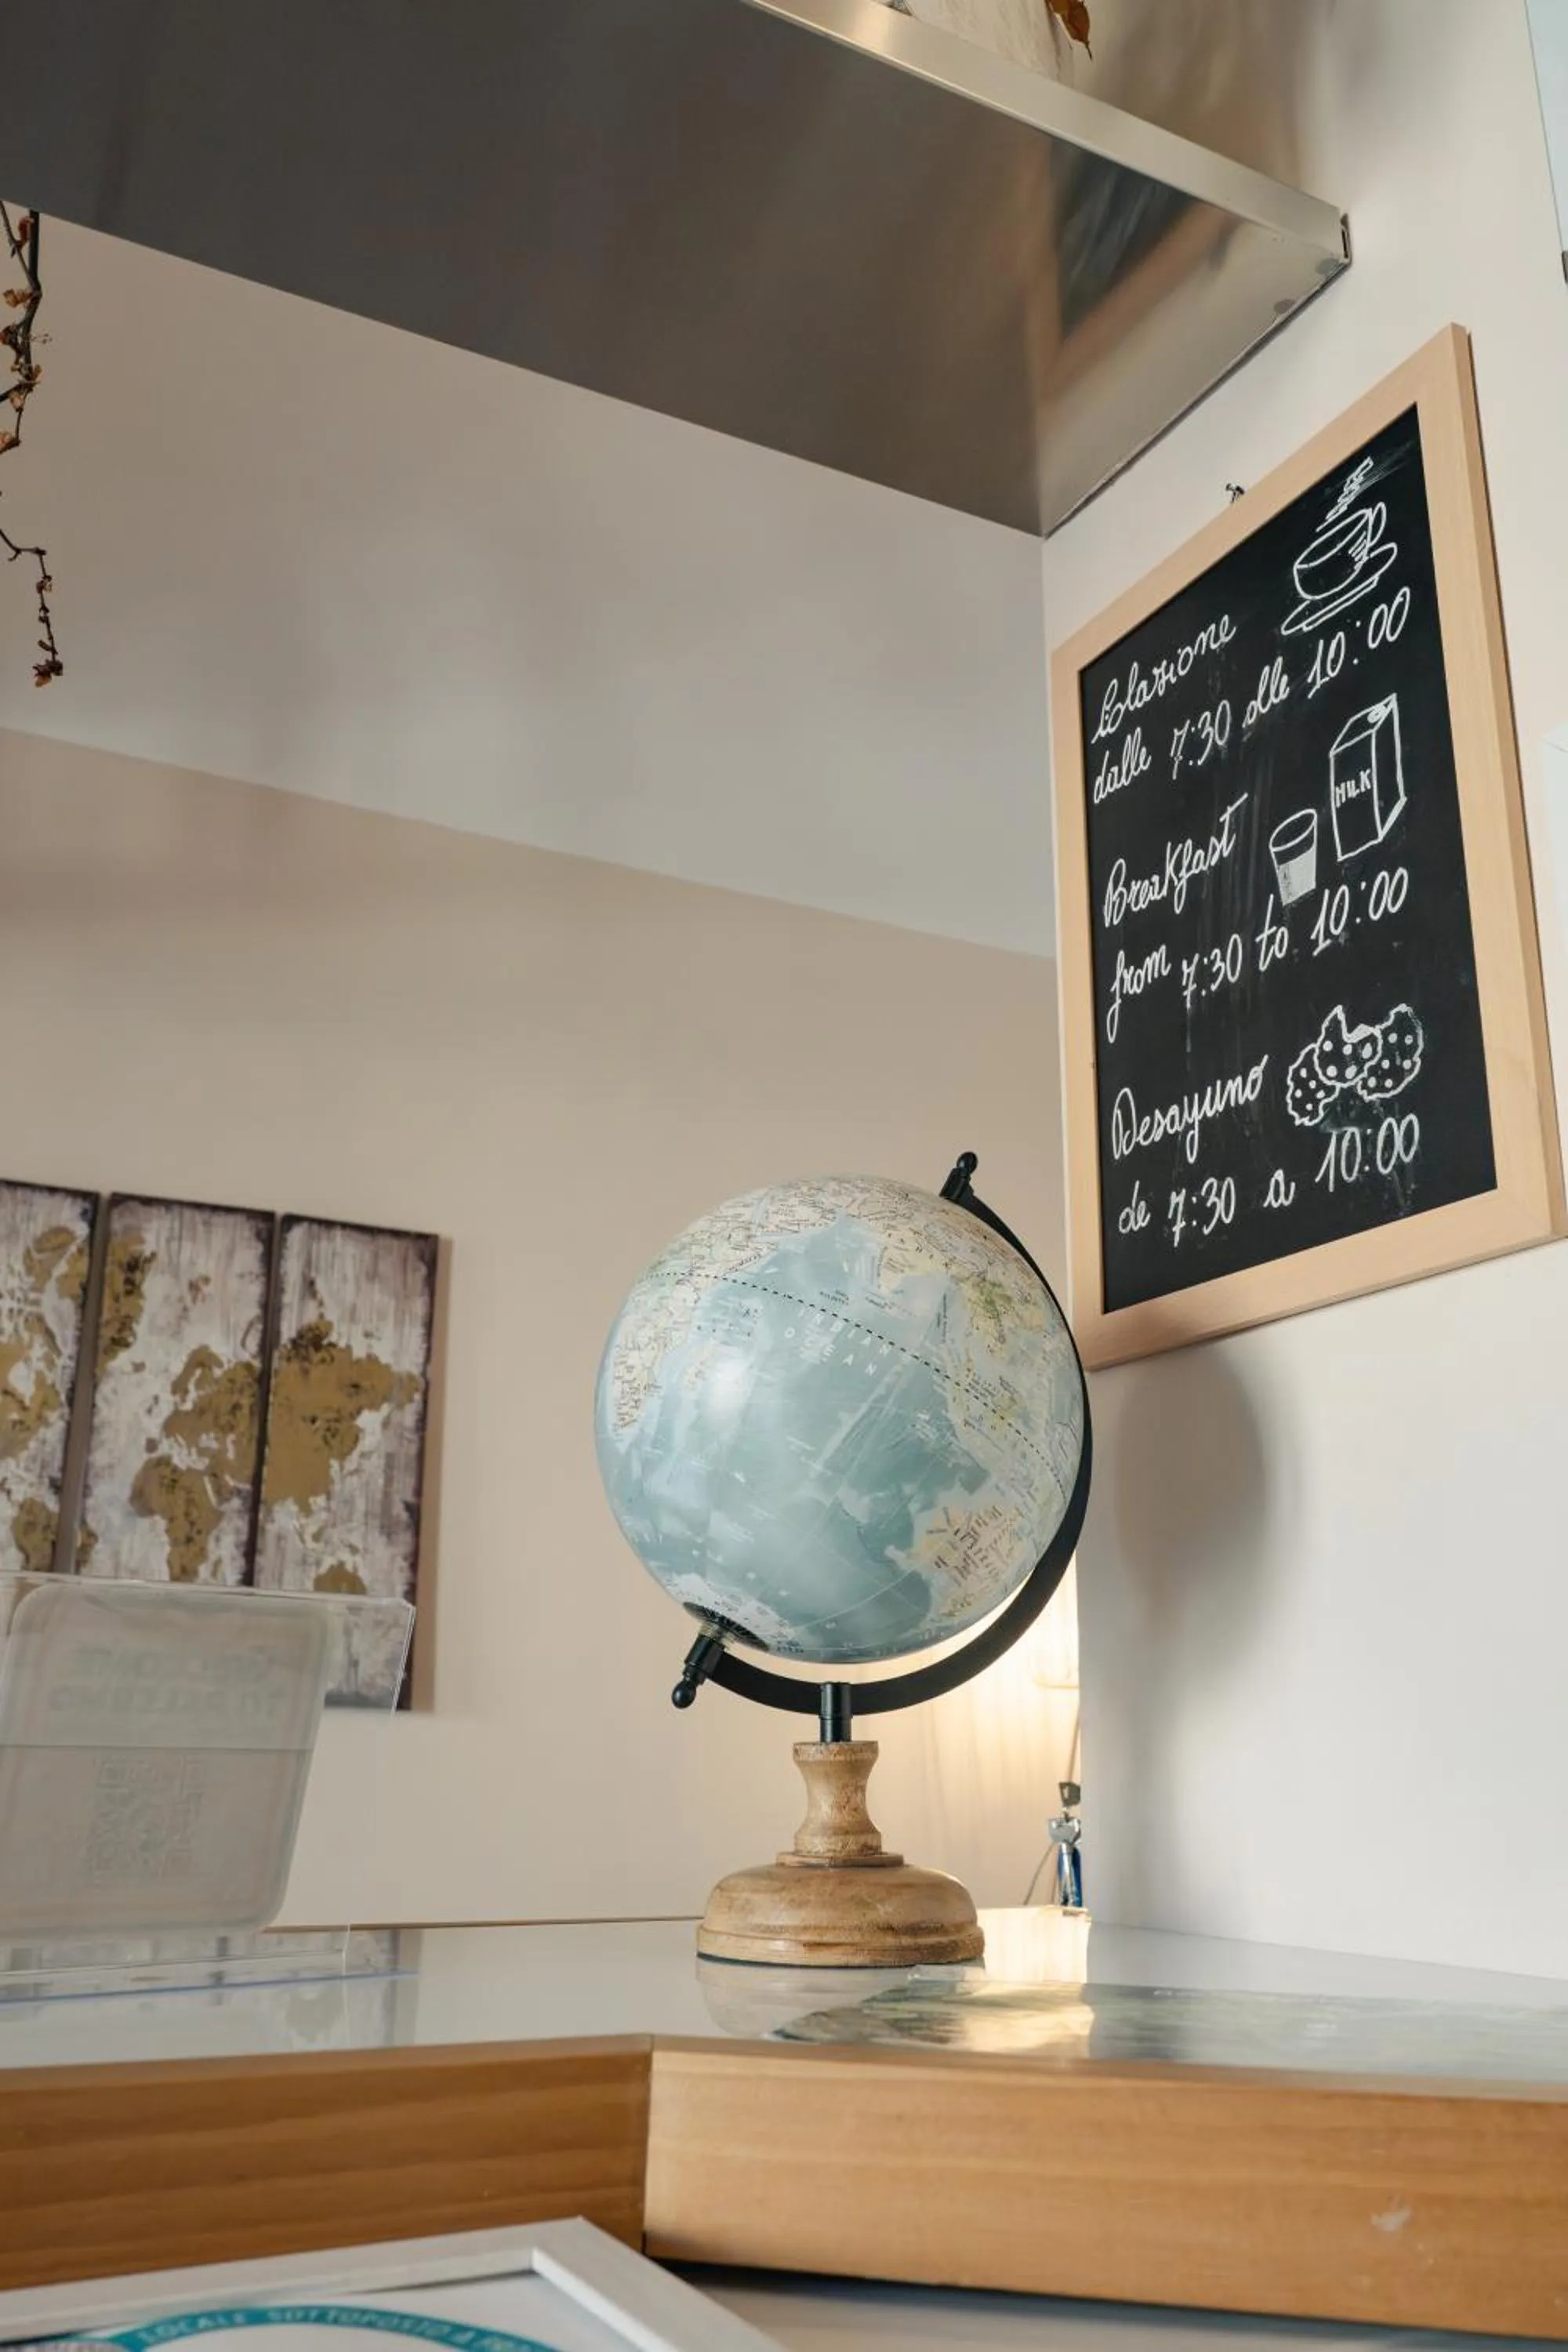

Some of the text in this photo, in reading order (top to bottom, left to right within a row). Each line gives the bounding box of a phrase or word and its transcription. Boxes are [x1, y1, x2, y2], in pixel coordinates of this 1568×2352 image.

[1093, 726, 1152, 805] dalle
[1170, 699, 1231, 780] 7:30
[1306, 586, 1411, 699] 10:00
[1334, 768, 1371, 808] MILK
[1102, 792, 1248, 927] Breakfast
[1106, 866, 1409, 1044] from 7:30 to 10:00
[1111, 1054, 1269, 1164] Desayuno
[1119, 1113, 1420, 1248] de 7:30 a 10:00
[784, 1327, 877, 1376] OCEAN
